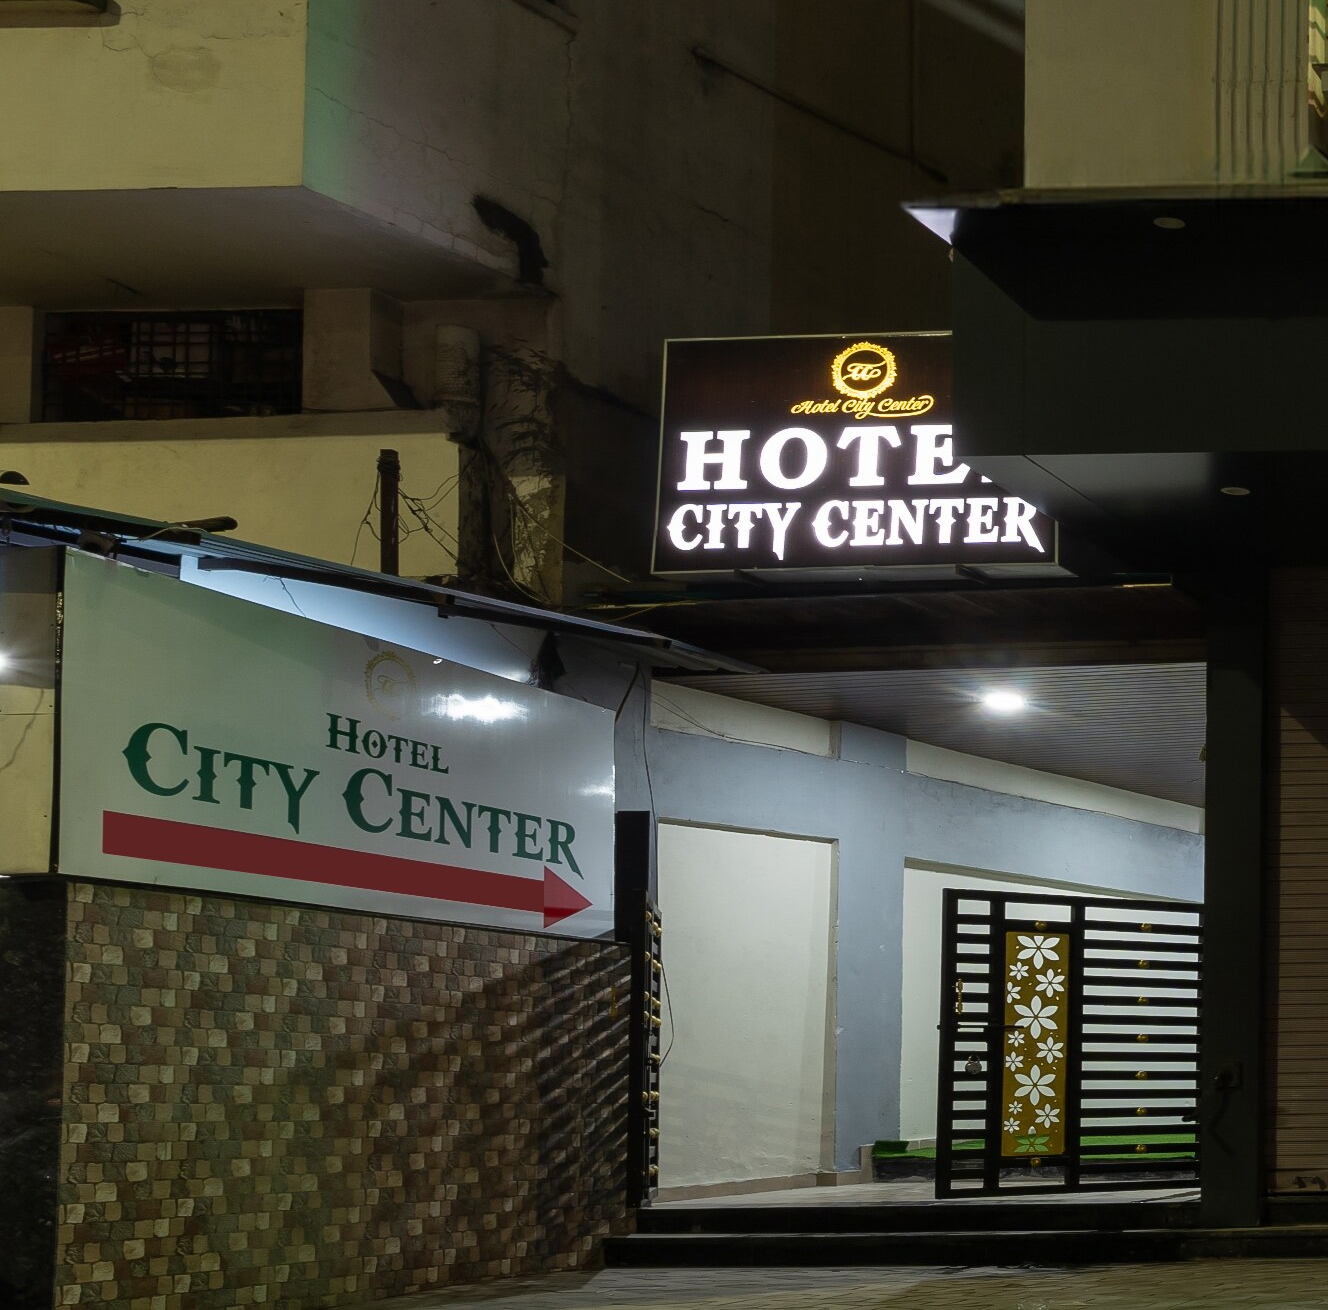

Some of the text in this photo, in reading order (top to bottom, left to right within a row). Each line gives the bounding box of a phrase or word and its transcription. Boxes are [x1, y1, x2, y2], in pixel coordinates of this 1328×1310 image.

[790, 394, 935, 420] Hotel City Center
[676, 424, 993, 491] HOTE
[666, 496, 1046, 561] CITY CENTER
[325, 712, 450, 775] HOTEL
[122, 722, 586, 880] CITY CENTER
